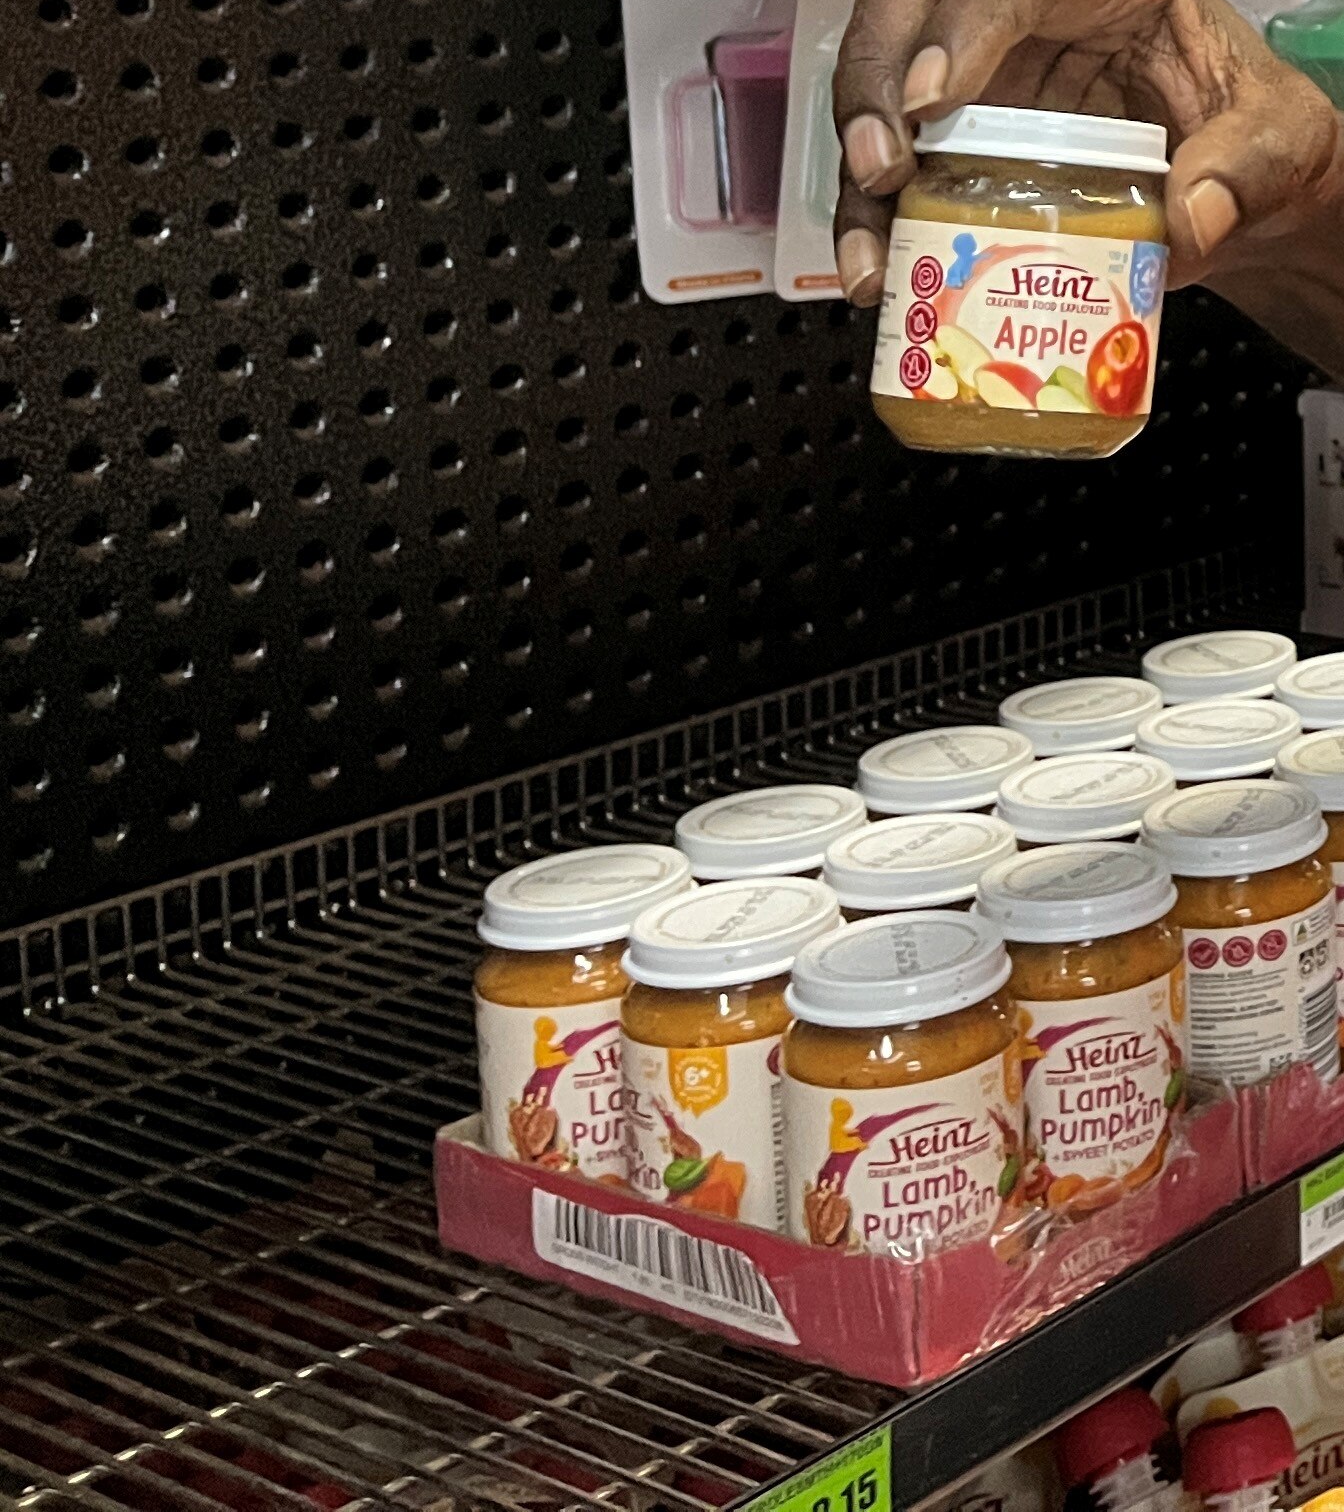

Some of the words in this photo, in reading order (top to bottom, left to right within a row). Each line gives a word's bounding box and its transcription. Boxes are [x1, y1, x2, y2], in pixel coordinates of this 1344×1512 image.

[988, 264, 1110, 304] Heinz
[993, 316, 1089, 360] Apple
[1046, 1035, 1157, 1074] Heinz
[1059, 1075, 1145, 1115] Lamb,
[868, 1120, 990, 1166] Heinz
[1040, 1097, 1162, 1145] Pumpkin
[883, 1165, 977, 1209] Lamb,
[863, 1184, 996, 1242] Pumpkin
